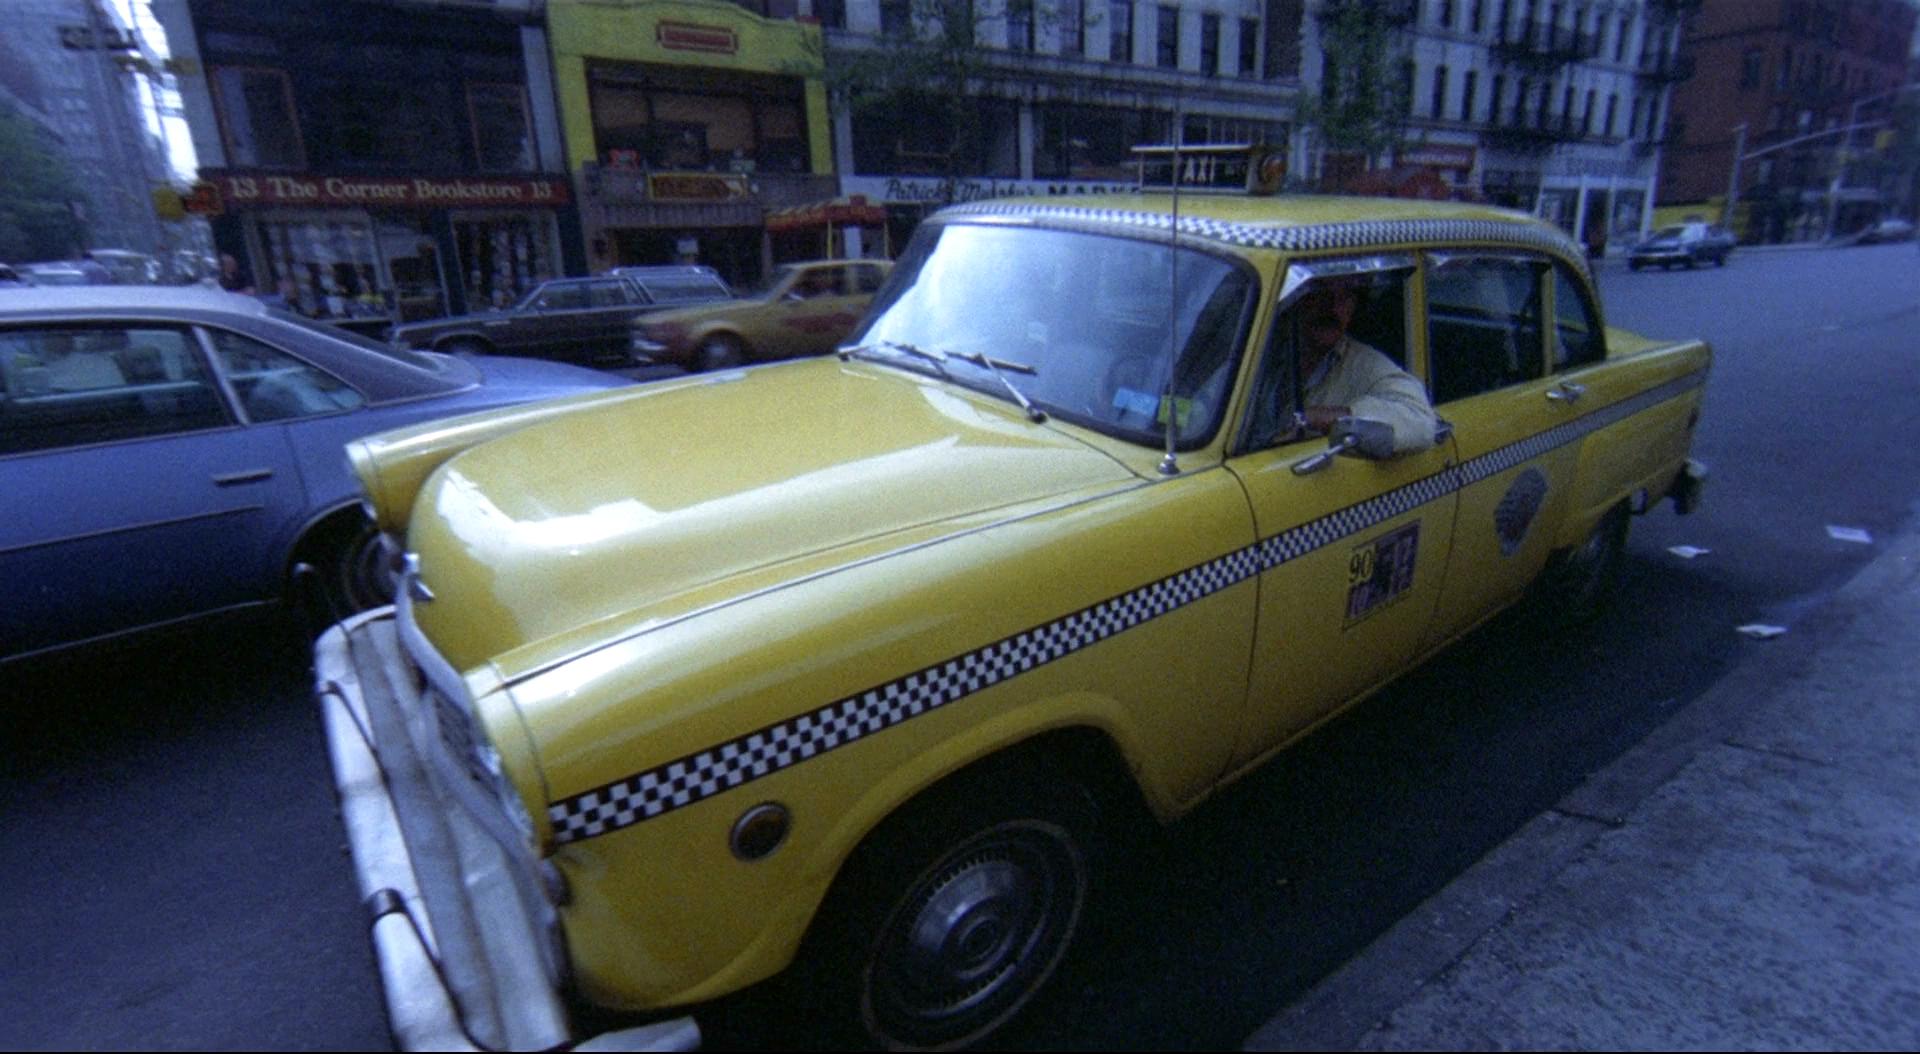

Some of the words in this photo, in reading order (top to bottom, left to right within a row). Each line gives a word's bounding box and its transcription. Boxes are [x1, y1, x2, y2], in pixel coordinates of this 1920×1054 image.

[229, 176, 258, 199] 13
[266, 177, 318, 198] The
[326, 177, 407, 198] Corner
[414, 179, 521, 198] Bookstore
[529, 181, 552, 199] 13
